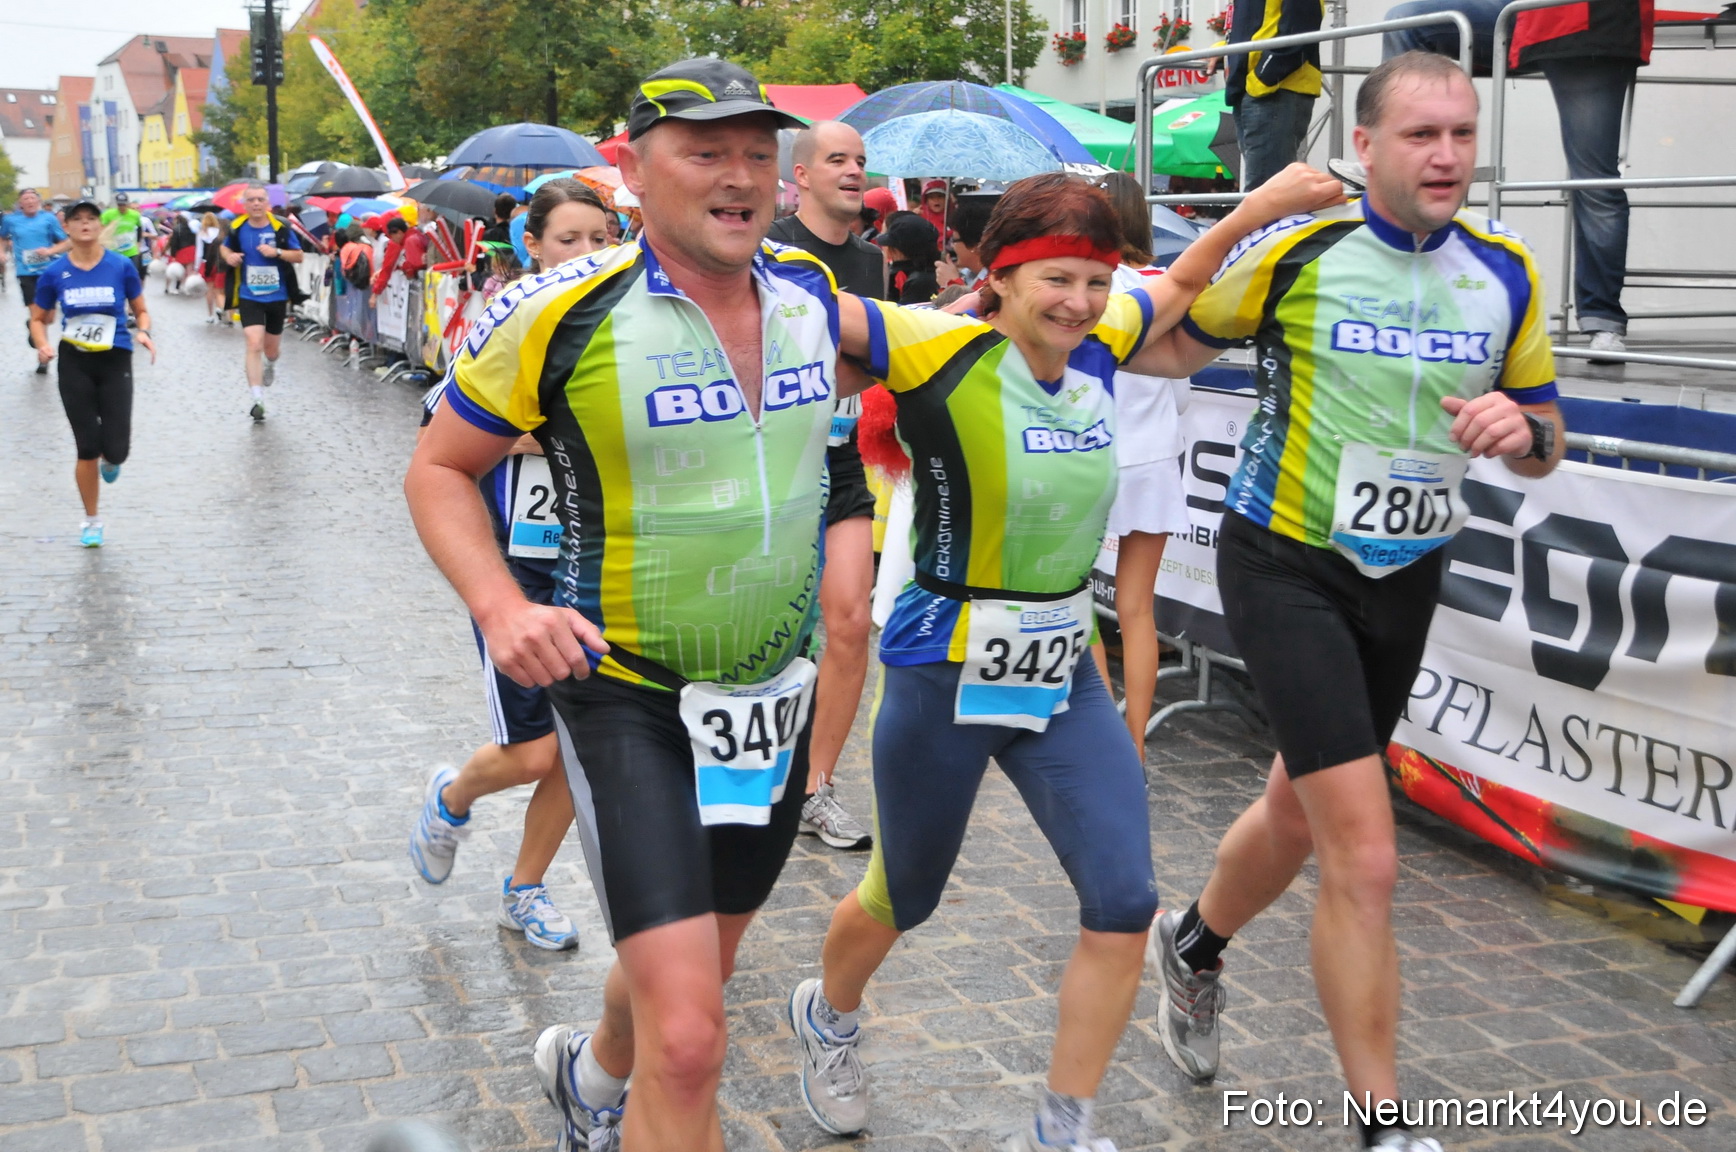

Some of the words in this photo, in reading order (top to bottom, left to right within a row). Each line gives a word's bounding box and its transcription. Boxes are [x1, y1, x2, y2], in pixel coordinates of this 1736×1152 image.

[1330, 319, 1492, 365] BOCK
[645, 361, 830, 428] BOCK
[1022, 418, 1113, 453] BOCK
[1350, 481, 1452, 535] 2807
[1400, 666, 1736, 835] PFLASTER
